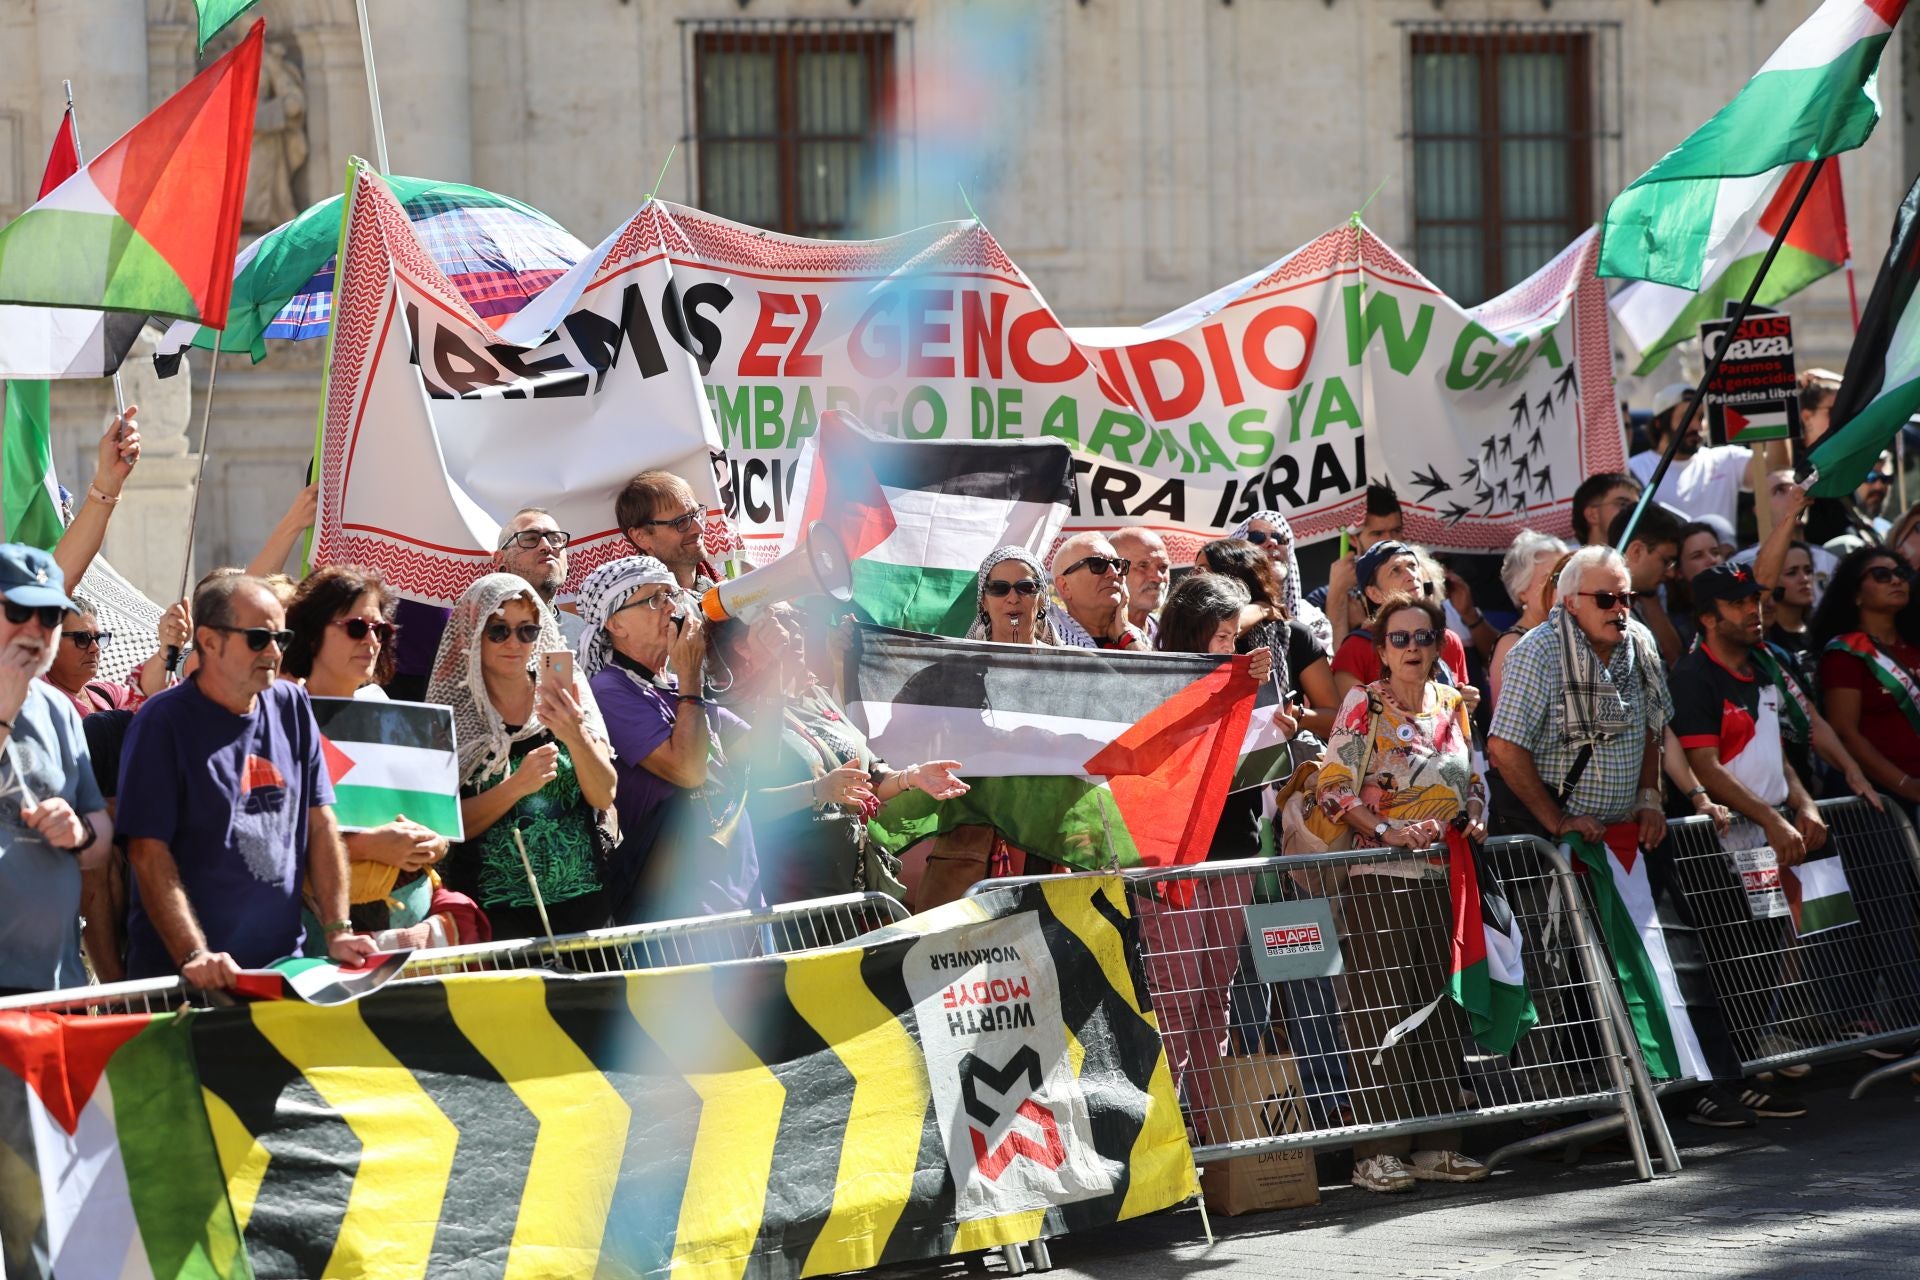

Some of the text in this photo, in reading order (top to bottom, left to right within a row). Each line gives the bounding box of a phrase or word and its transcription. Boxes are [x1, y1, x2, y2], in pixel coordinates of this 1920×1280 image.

[1719, 362, 1781, 374] Paremos
[1708, 374, 1796, 393] el genocidio
[1708, 391, 1766, 404] Palestina
[971, 386, 1023, 440] DE
[1287, 375, 1362, 443] YA
[1265, 930, 1319, 944] BLAPE
[929, 946, 1020, 970] WORKWEAR
[943, 976, 1031, 1009] MODYF
[946, 1002, 1036, 1036] WÜRTH
